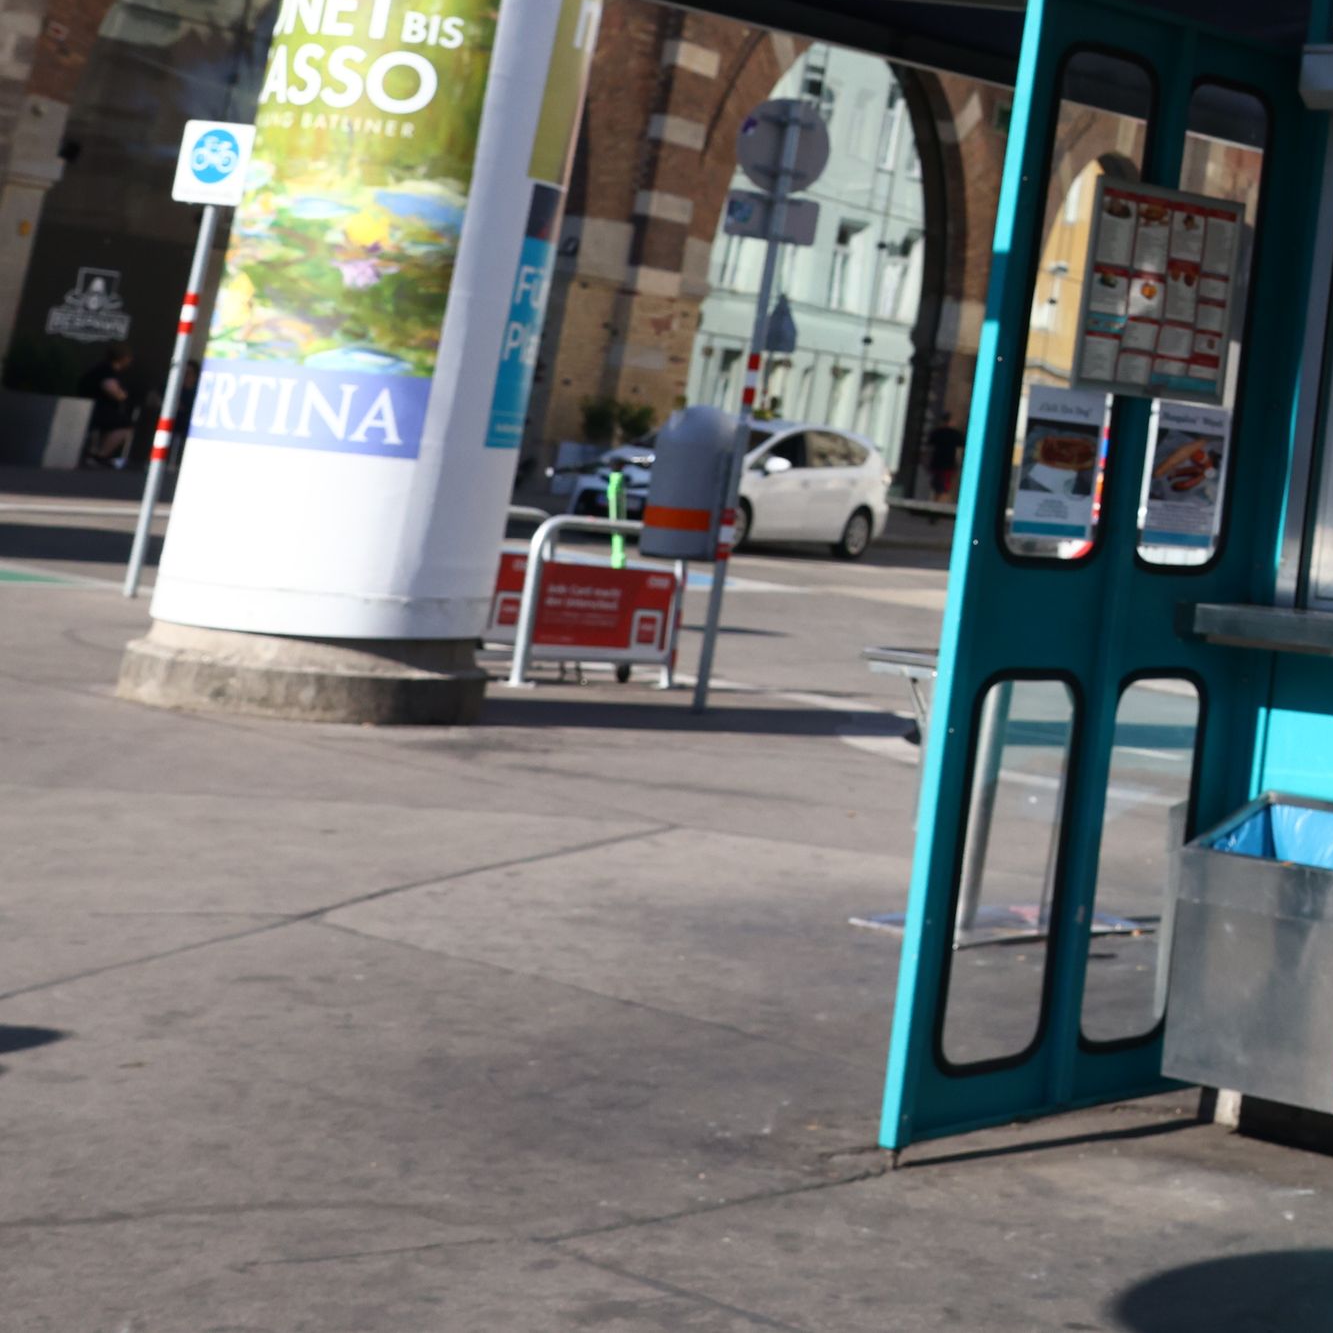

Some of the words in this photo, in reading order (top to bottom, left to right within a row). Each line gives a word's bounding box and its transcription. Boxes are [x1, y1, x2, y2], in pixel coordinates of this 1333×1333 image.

[400, 10, 465, 50] BIS
[258, 42, 438, 114] ASSO
[191, 370, 403, 446] ERTINA
